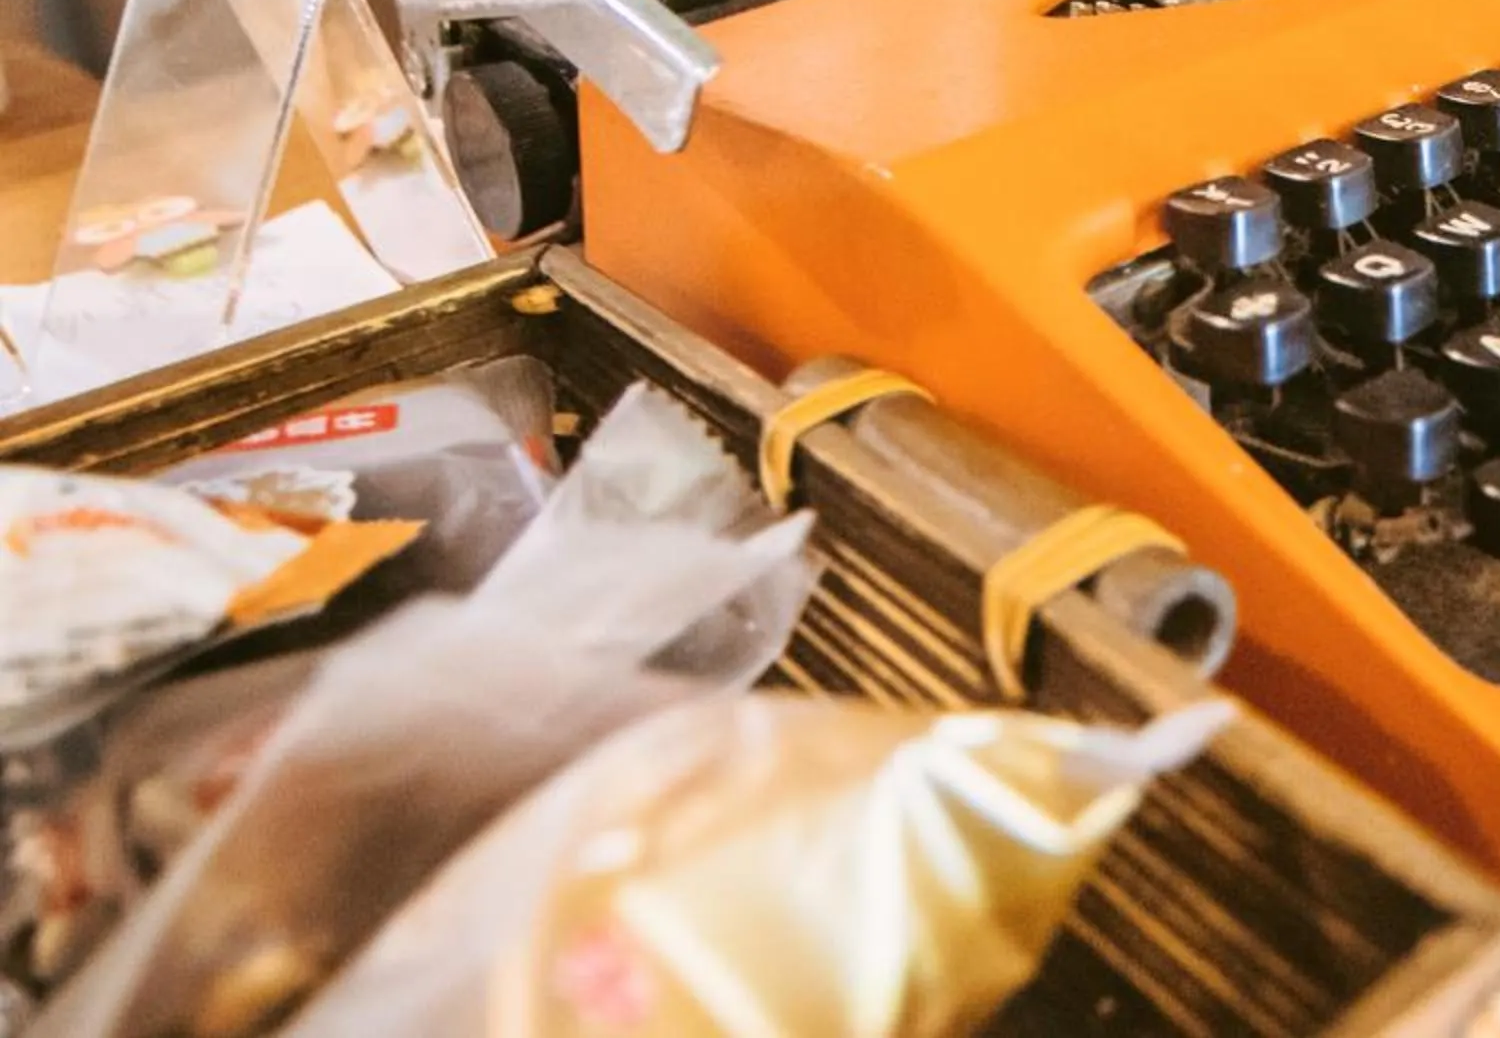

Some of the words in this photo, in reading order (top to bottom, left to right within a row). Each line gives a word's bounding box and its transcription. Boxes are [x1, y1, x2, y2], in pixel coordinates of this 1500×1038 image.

[1316, 159, 1352, 174] 2
[1354, 254, 1405, 278] Q
[1438, 212, 1492, 238] W
